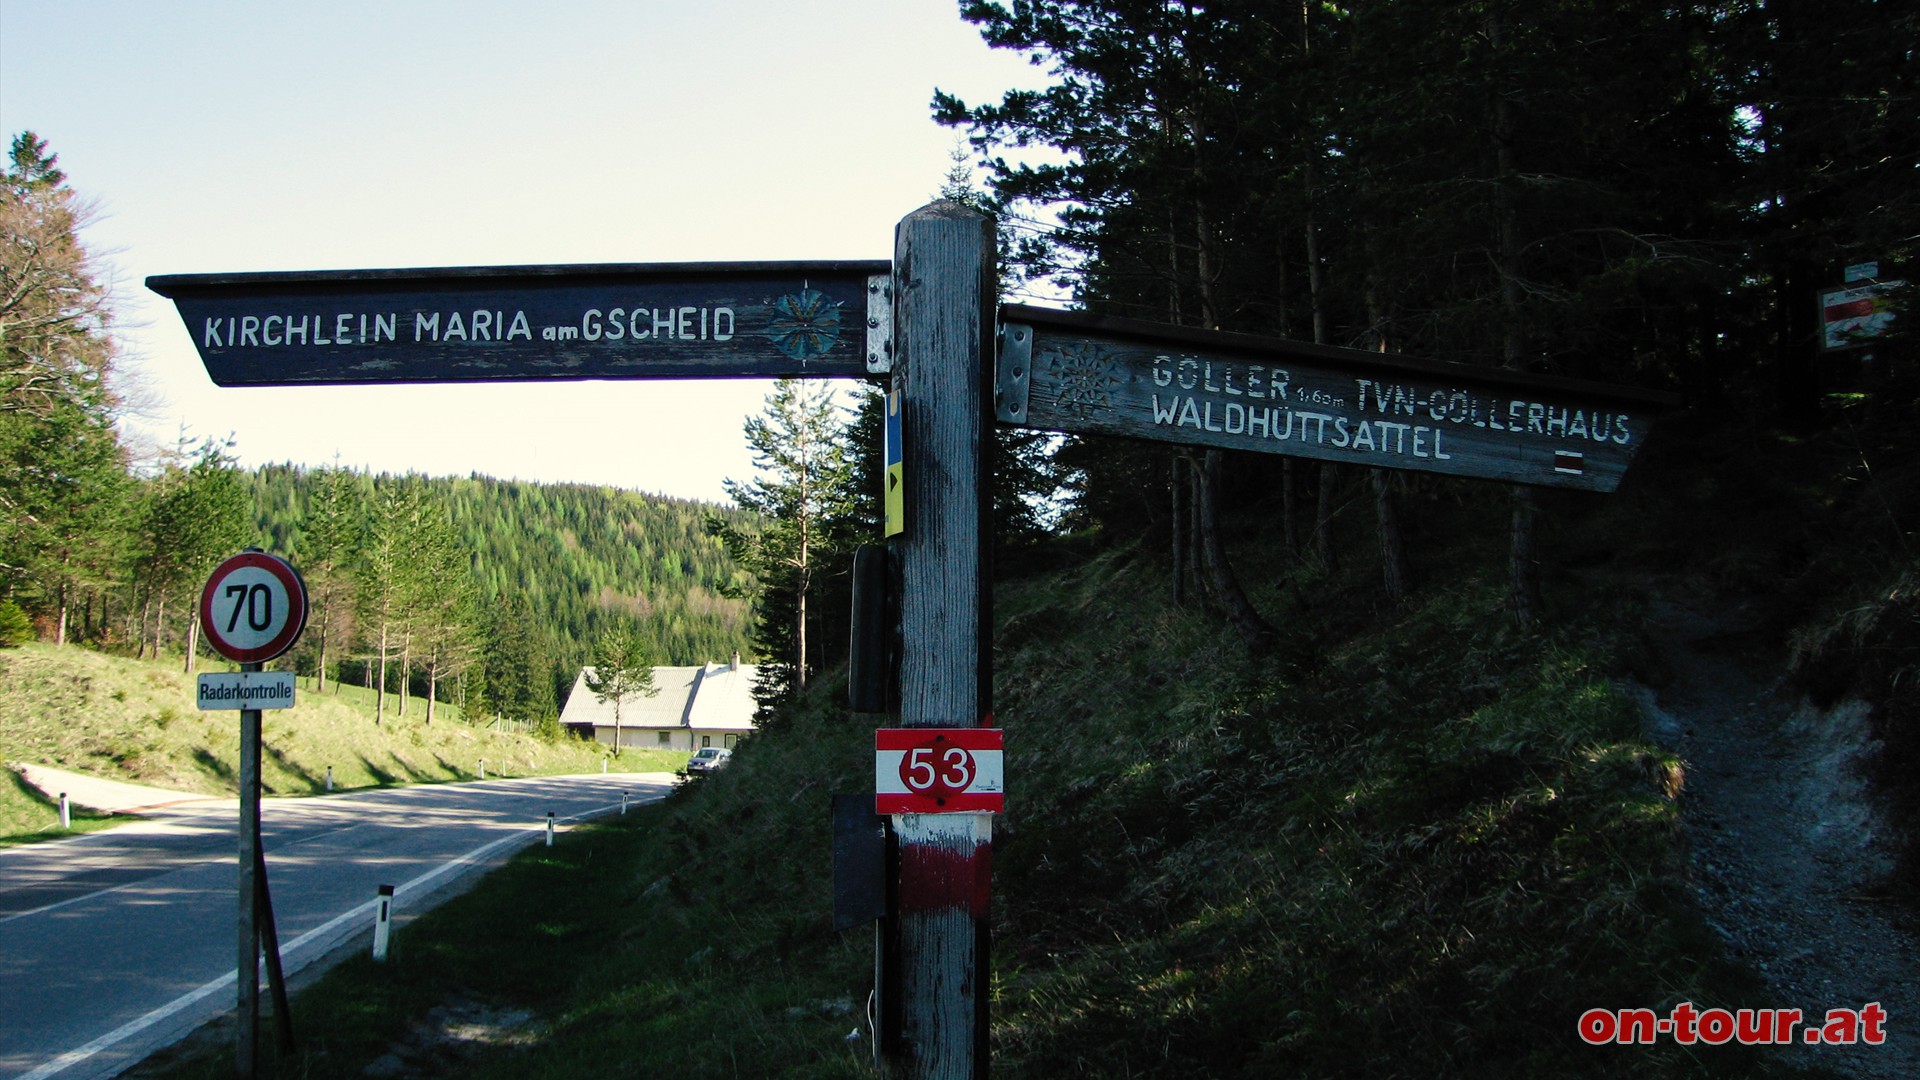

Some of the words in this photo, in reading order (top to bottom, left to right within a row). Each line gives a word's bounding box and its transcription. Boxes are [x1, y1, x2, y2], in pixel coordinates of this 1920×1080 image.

[205, 313, 396, 348] KIRCHLEIN
[415, 309, 532, 342] MARIA
[542, 326, 579, 341] am
[582, 306, 735, 341] GSCHEID
[1152, 354, 1290, 400] GÖLLER
[1355, 379, 1630, 445] TVN-GÖLLERHAUS
[1152, 394, 1450, 460] WALDHÜTTSATTEL
[226, 583, 272, 633] 70
[200, 682, 292, 700] Radarkontrolle
[909, 748, 969, 789] 53
